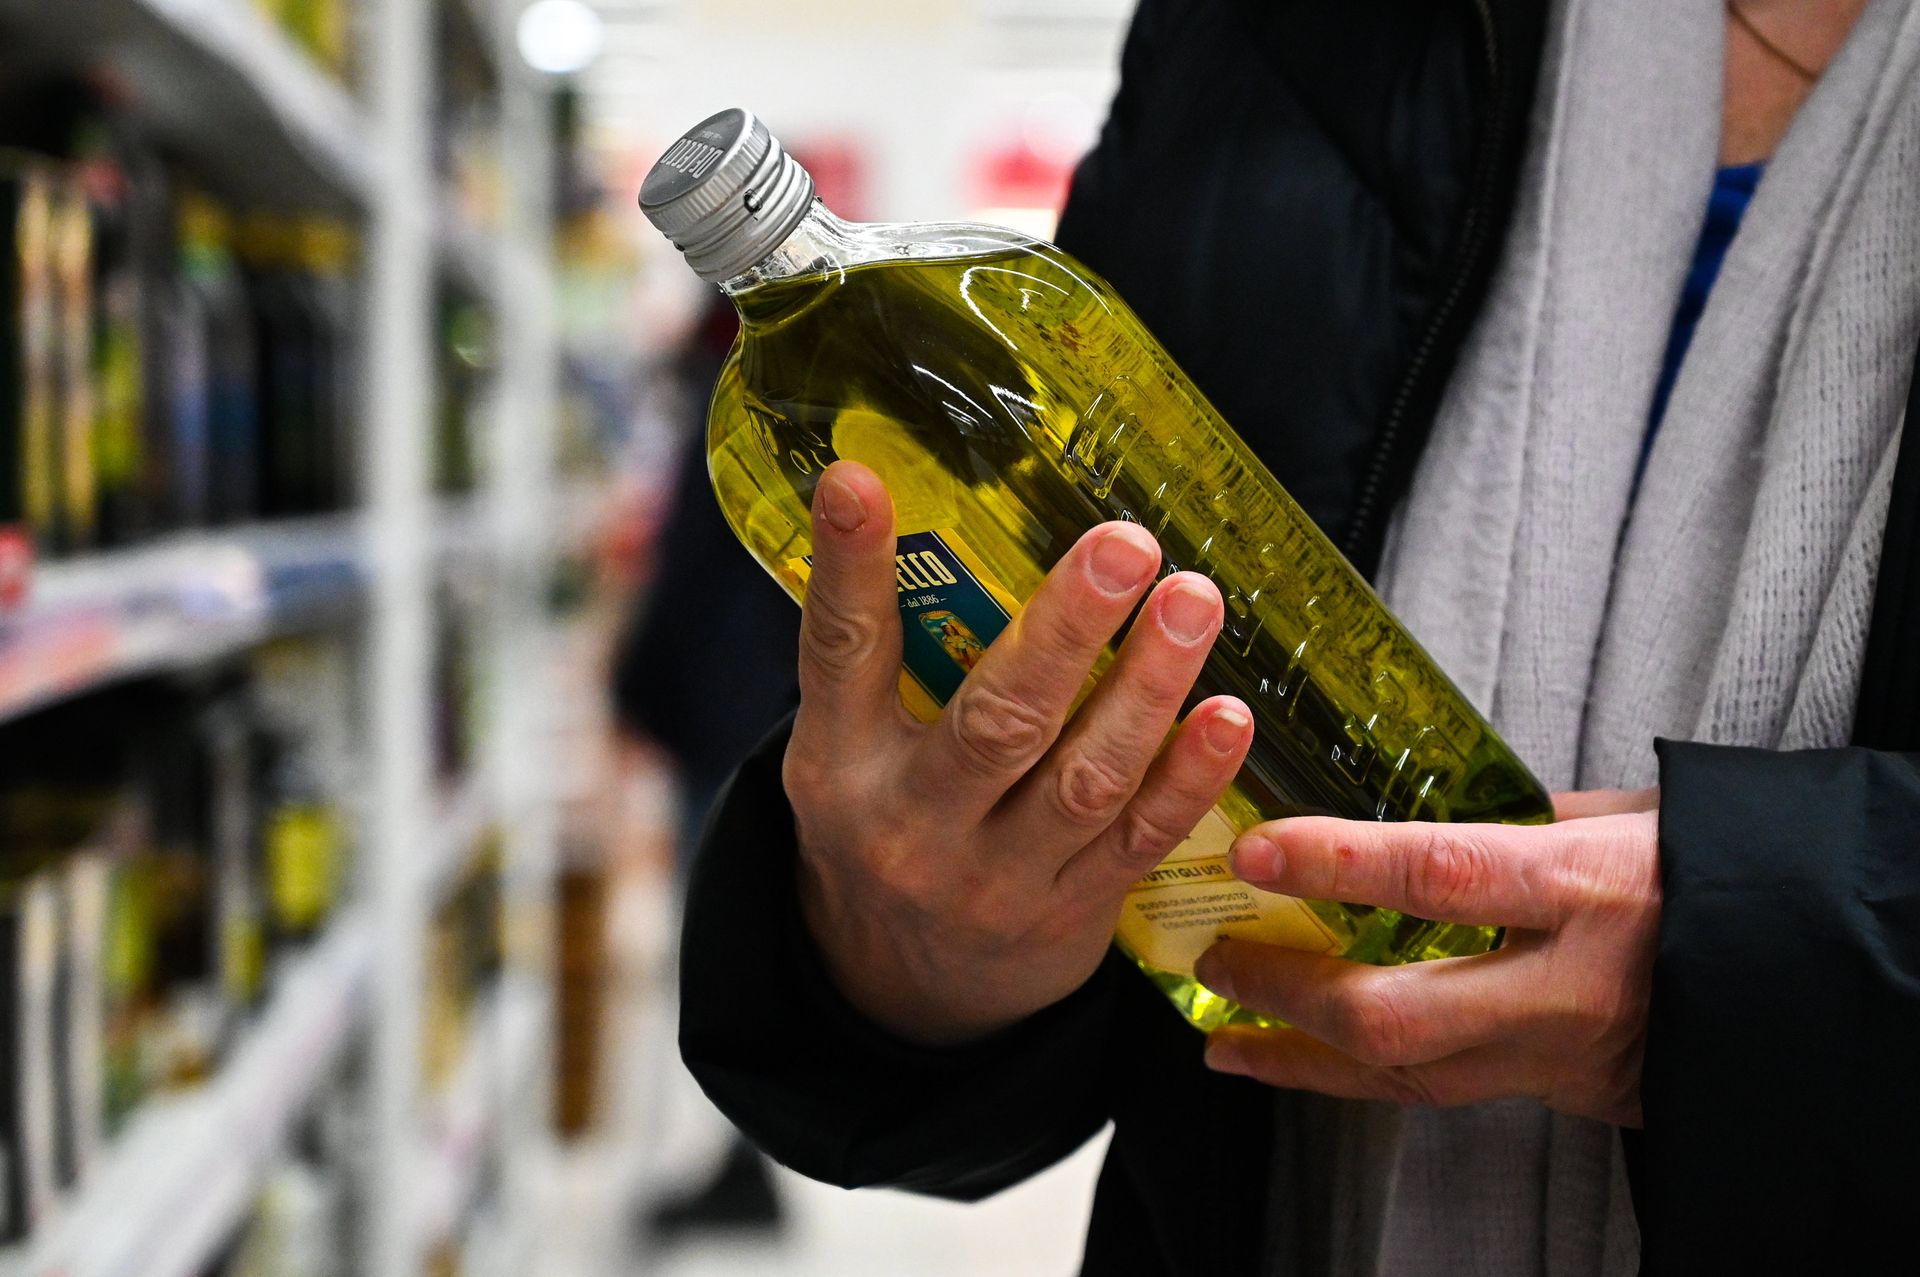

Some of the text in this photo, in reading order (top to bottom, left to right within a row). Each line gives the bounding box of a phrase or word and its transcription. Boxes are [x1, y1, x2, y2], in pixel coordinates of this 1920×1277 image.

[896, 552, 957, 592] ECCO
[1179, 867, 1202, 878] GLI
[1201, 864, 1226, 876] USI
